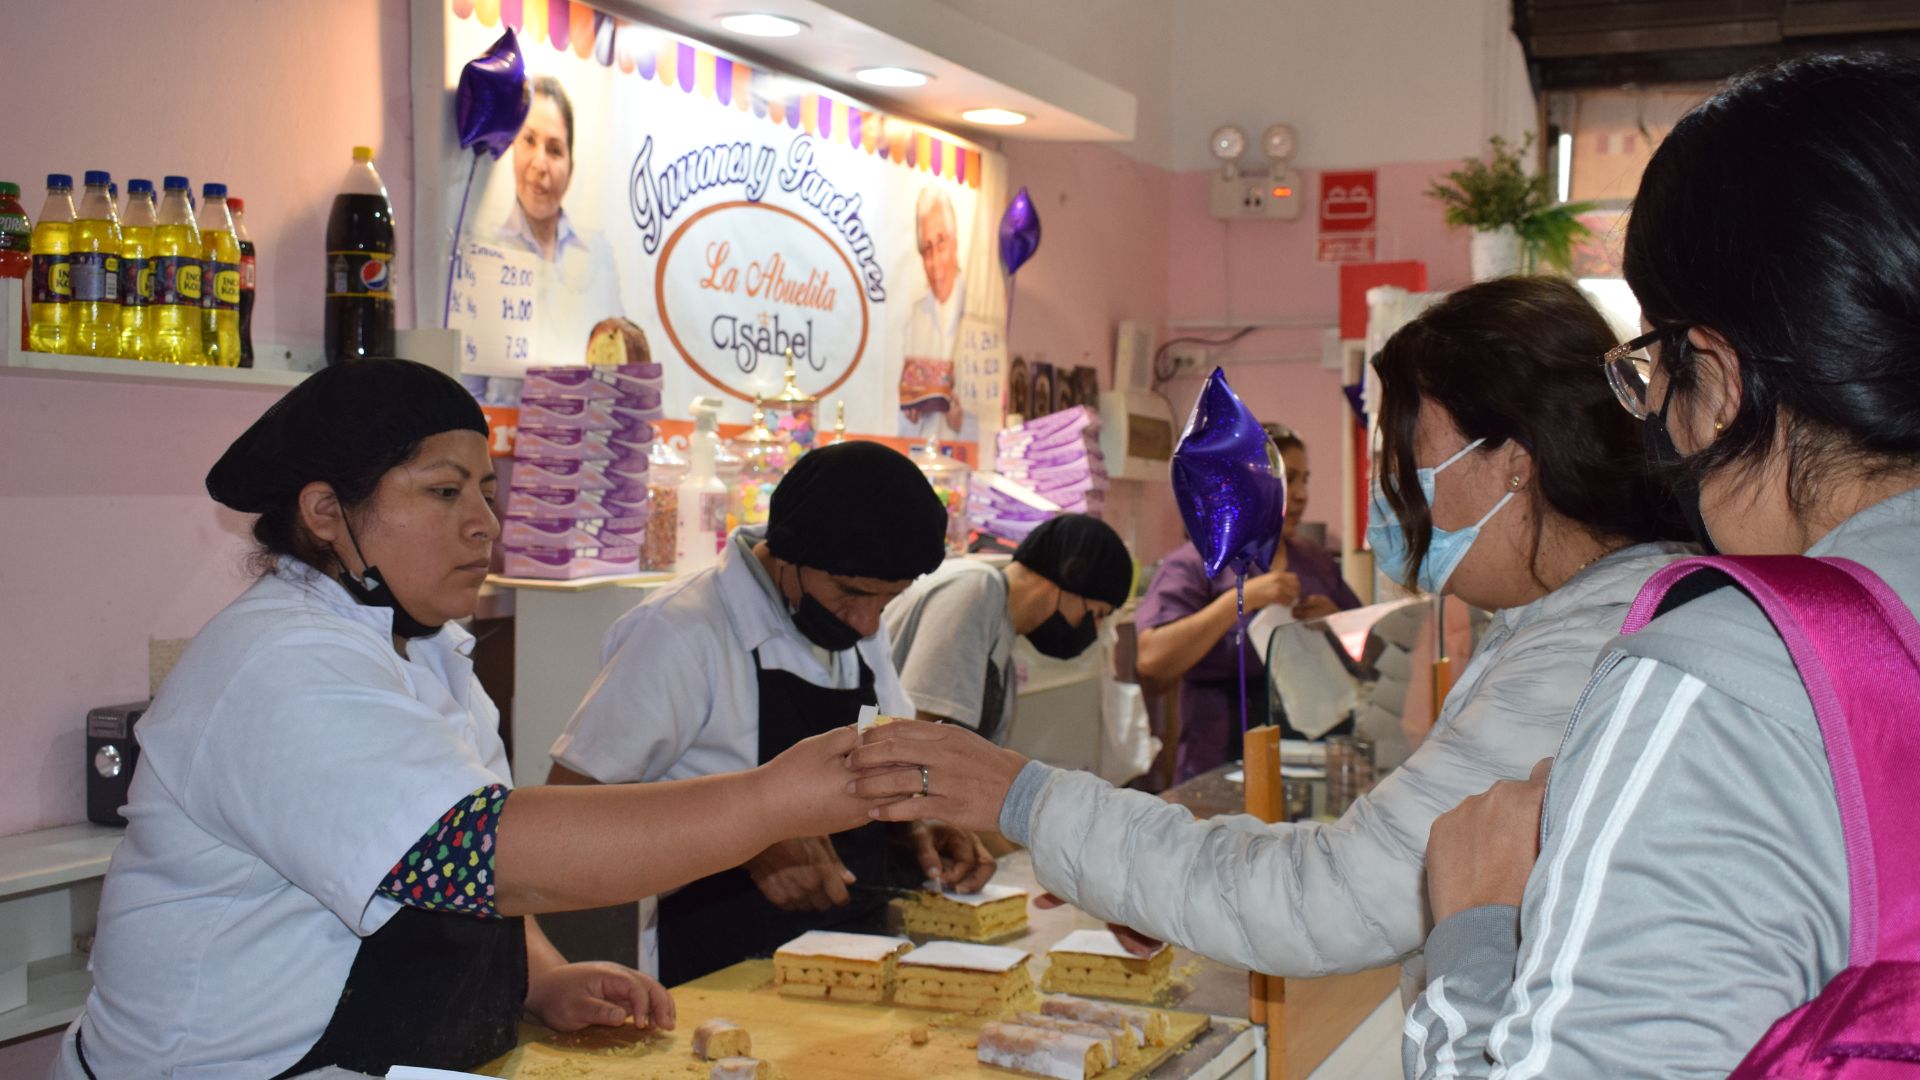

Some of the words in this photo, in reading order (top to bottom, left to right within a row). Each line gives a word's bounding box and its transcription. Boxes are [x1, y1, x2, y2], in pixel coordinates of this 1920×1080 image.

[746, 146, 776, 202] y
[699, 240, 738, 293] La
[745, 251, 837, 312] Abuelita
[711, 313, 827, 373] Isabel
